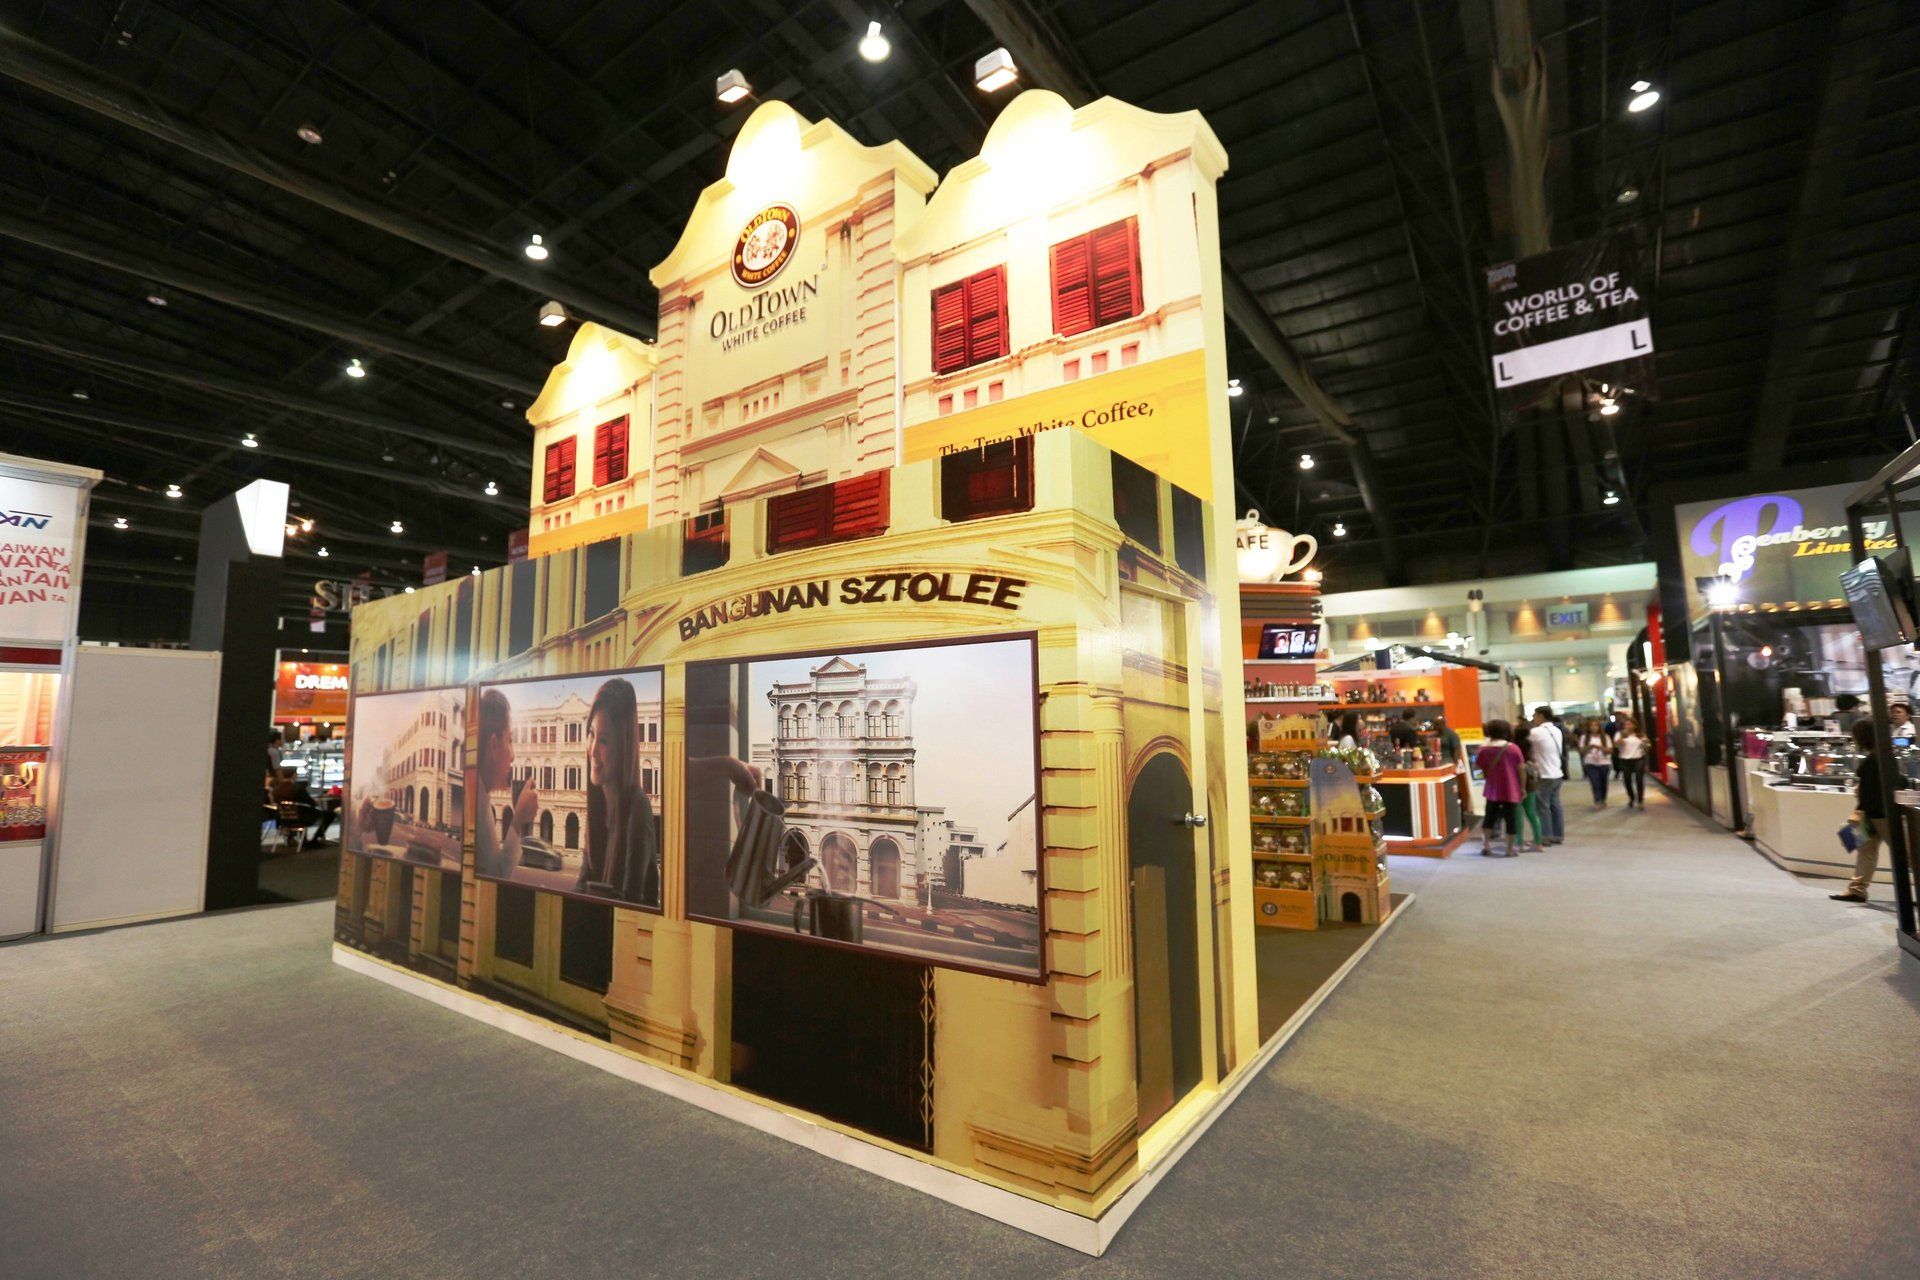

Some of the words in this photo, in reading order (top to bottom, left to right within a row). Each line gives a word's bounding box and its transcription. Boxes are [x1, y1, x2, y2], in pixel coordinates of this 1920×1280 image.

[742, 268, 762, 281] WHITE
[762, 252, 787, 277] COFFEE
[1494, 304, 1570, 336] COFFEE
[1574, 299, 1594, 315] &
[1595, 286, 1640, 310] TEA
[1504, 282, 1584, 315] WORLD
[1589, 272, 1620, 293] OF
[722, 326, 759, 352] WHITE
[762, 306, 807, 336] COFFEE
[1082, 401, 1155, 428] Coffee,
[678, 580, 830, 642] BANGUNAN
[1550, 610, 1584, 625] EXIT
